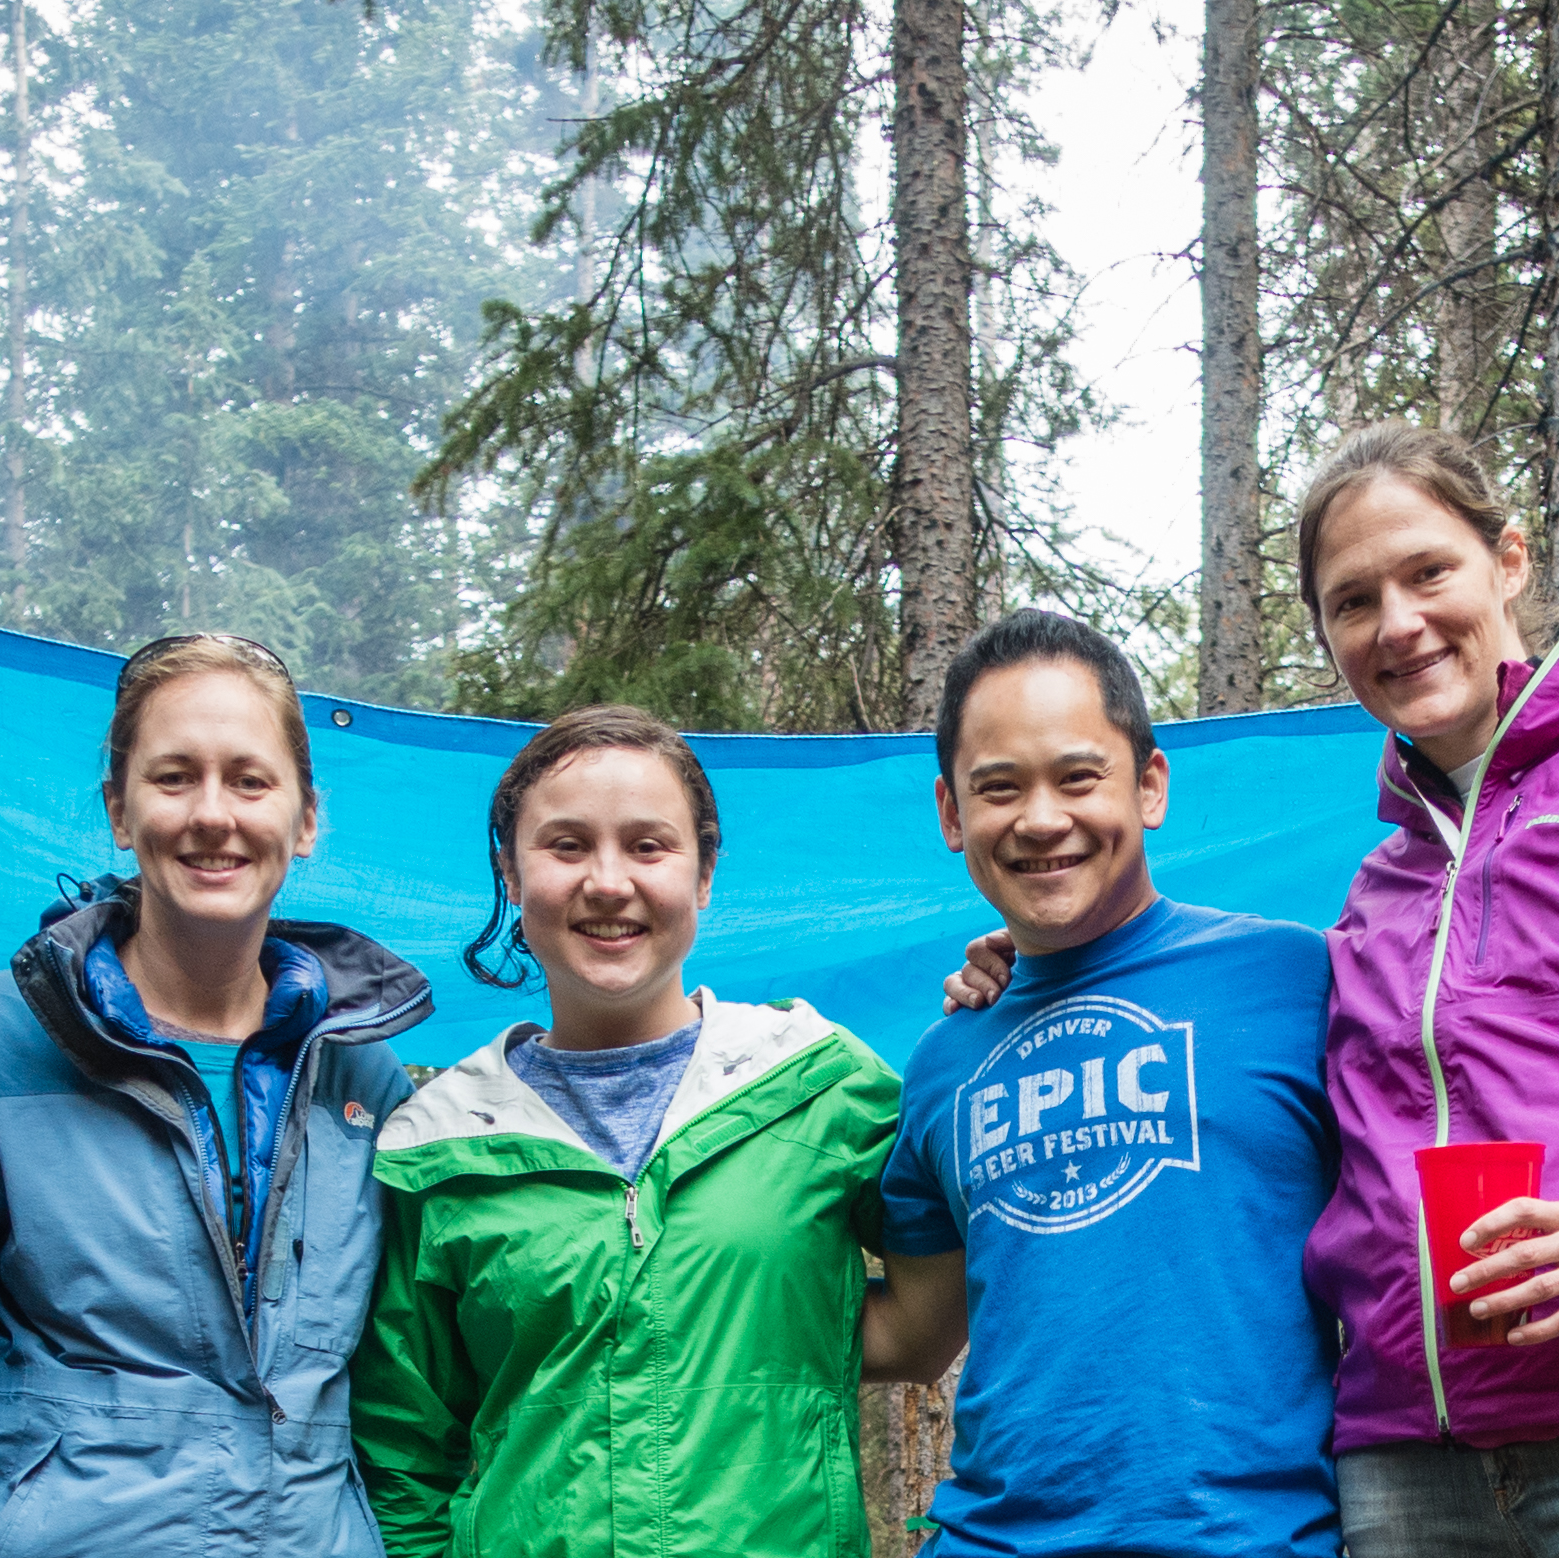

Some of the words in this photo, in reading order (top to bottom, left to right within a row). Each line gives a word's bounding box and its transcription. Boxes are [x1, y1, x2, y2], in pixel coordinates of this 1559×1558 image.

[1016, 1017, 1112, 1060] DENVER
[968, 1043, 1170, 1163] EPIC
[969, 1136, 1036, 1193] BEER
[1043, 1119, 1174, 1160] FESTIVAL
[1049, 1182, 1098, 1212] 2013
